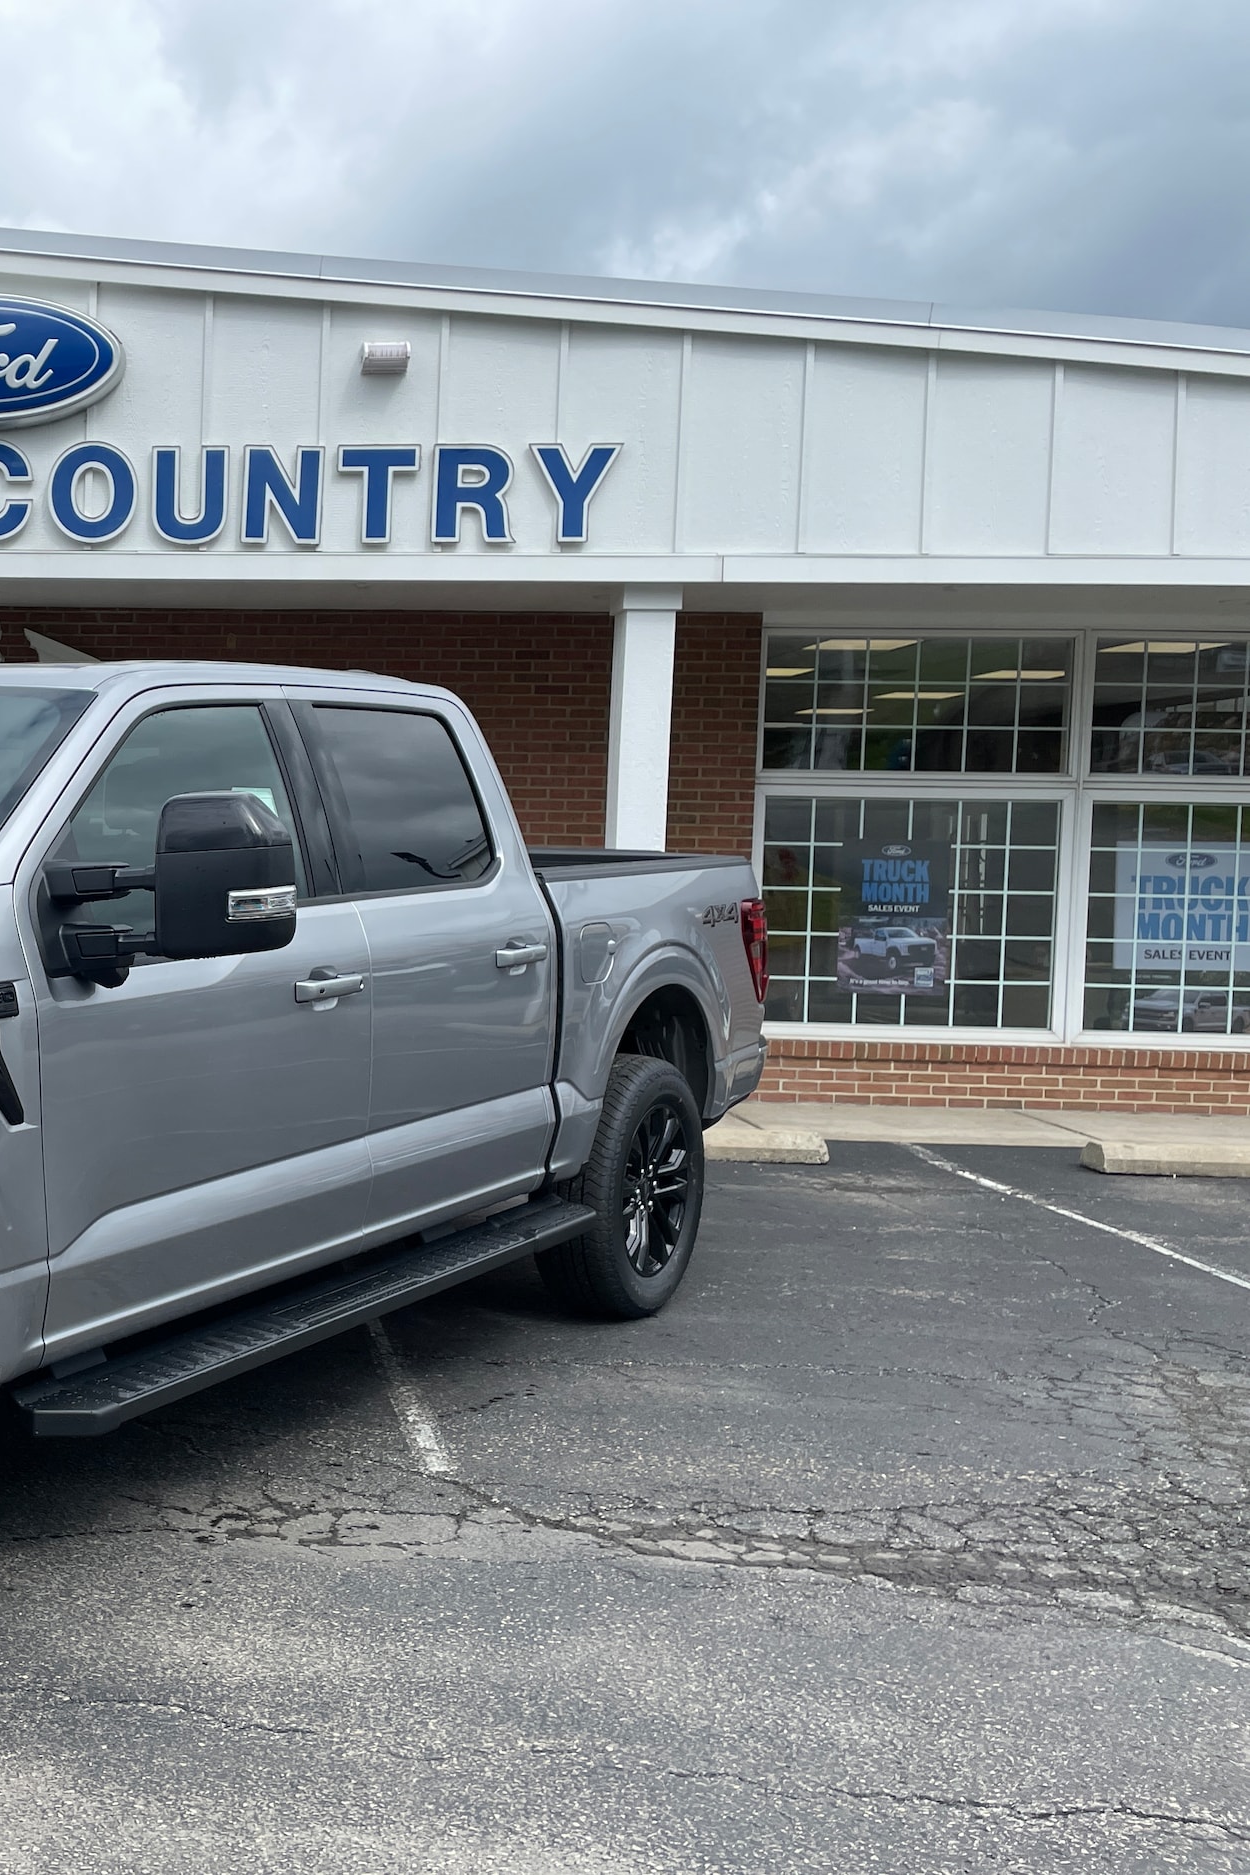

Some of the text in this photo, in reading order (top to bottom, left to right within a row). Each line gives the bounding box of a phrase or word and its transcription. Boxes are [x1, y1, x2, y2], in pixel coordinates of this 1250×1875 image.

[861, 859, 930, 882] TRUCK
[861, 882, 930, 904] MONTH
[1131, 875, 1250, 911] TRUCK
[868, 904, 921, 913] SALES EVENT
[1137, 913, 1249, 941] MONTH
[1144, 949, 1232, 961] SALES EVENT
